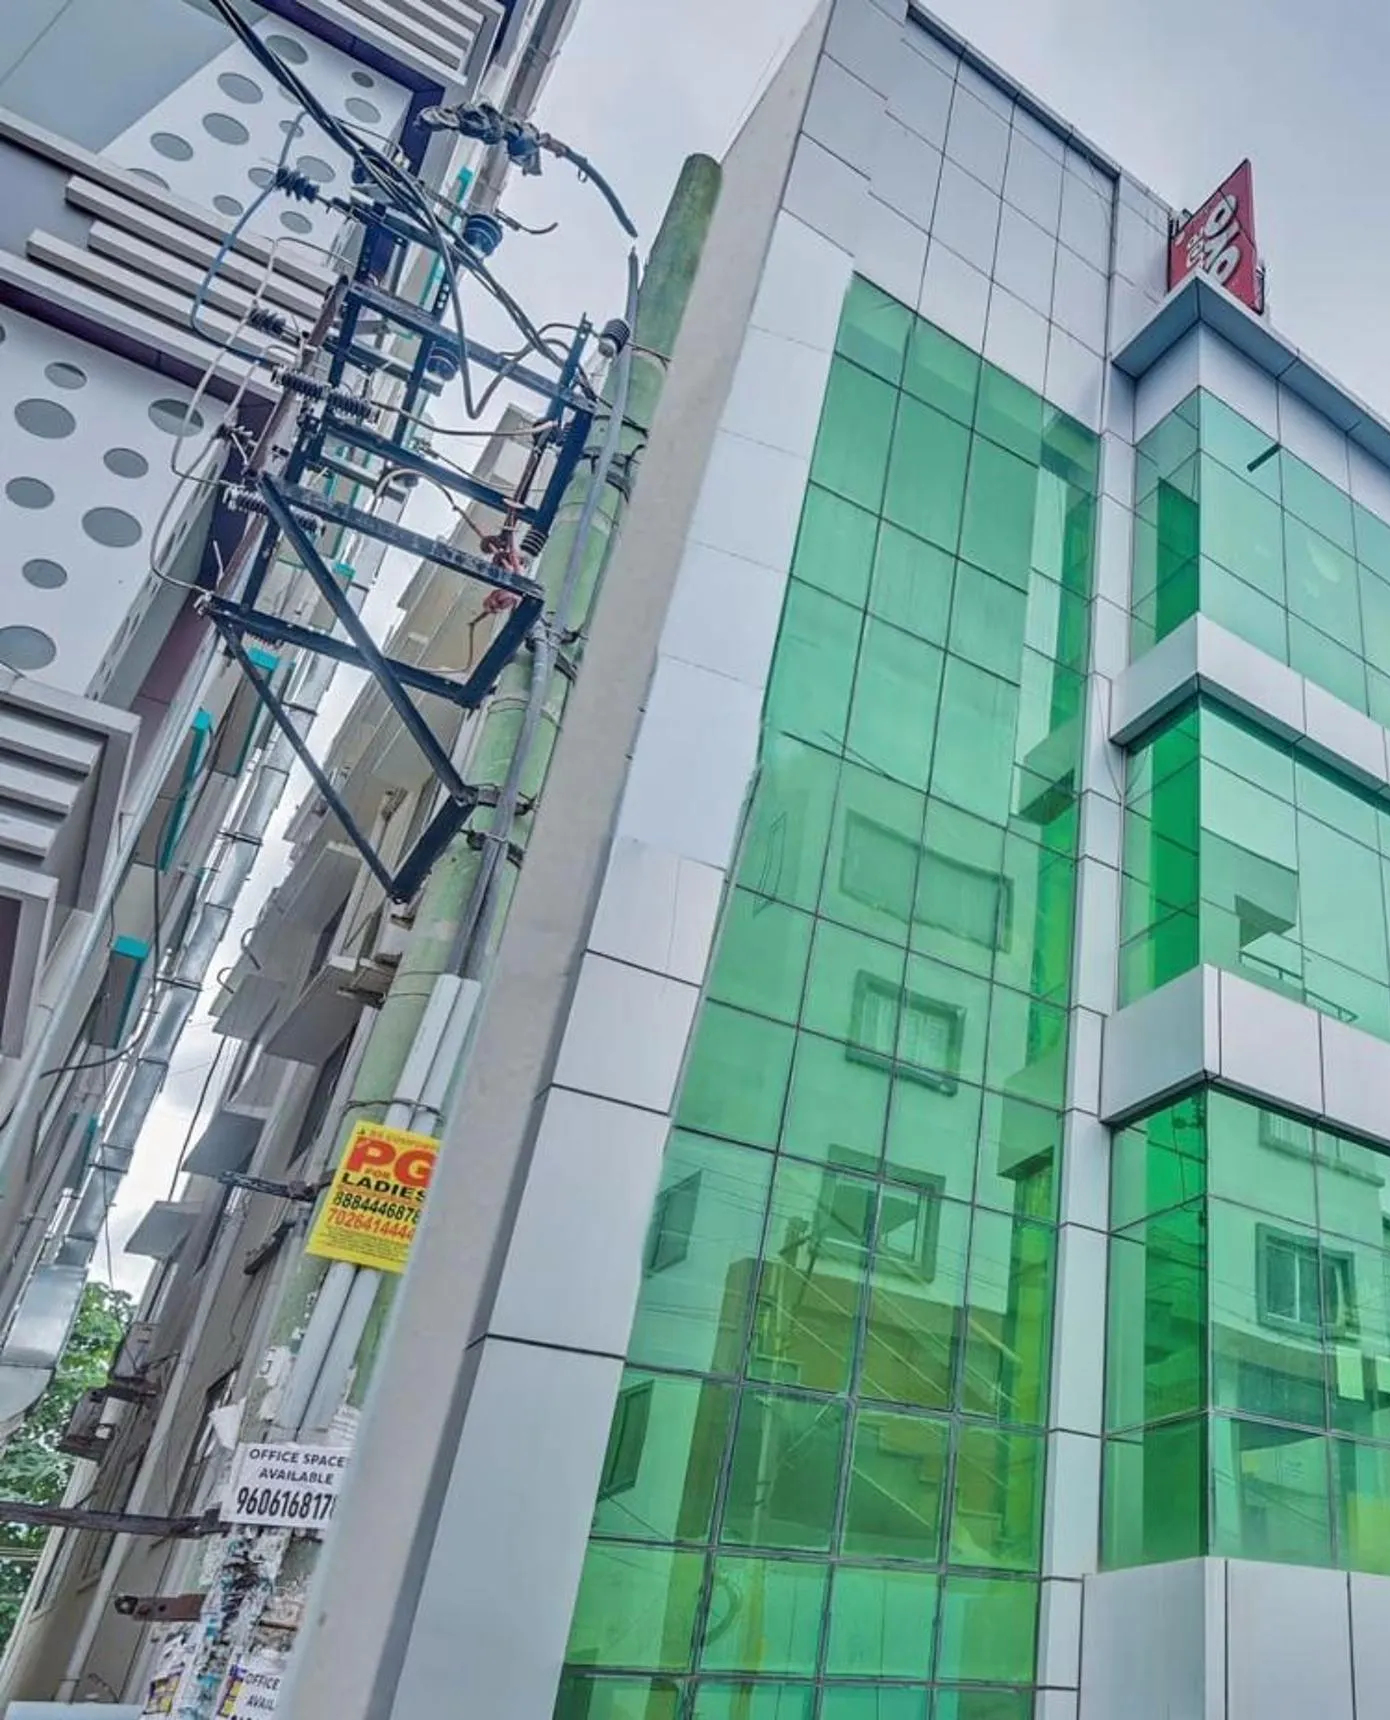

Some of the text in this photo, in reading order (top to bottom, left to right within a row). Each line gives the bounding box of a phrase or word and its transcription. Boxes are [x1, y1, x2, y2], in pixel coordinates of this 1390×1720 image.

[346, 1136, 437, 1188] PG
[342, 1172, 426, 1203] LADIES
[250, 1449, 347, 1468] OFFICE SPACE
[258, 1468, 334, 1486] AVAILABLE
[245, 1673, 281, 1690] OFFICE
